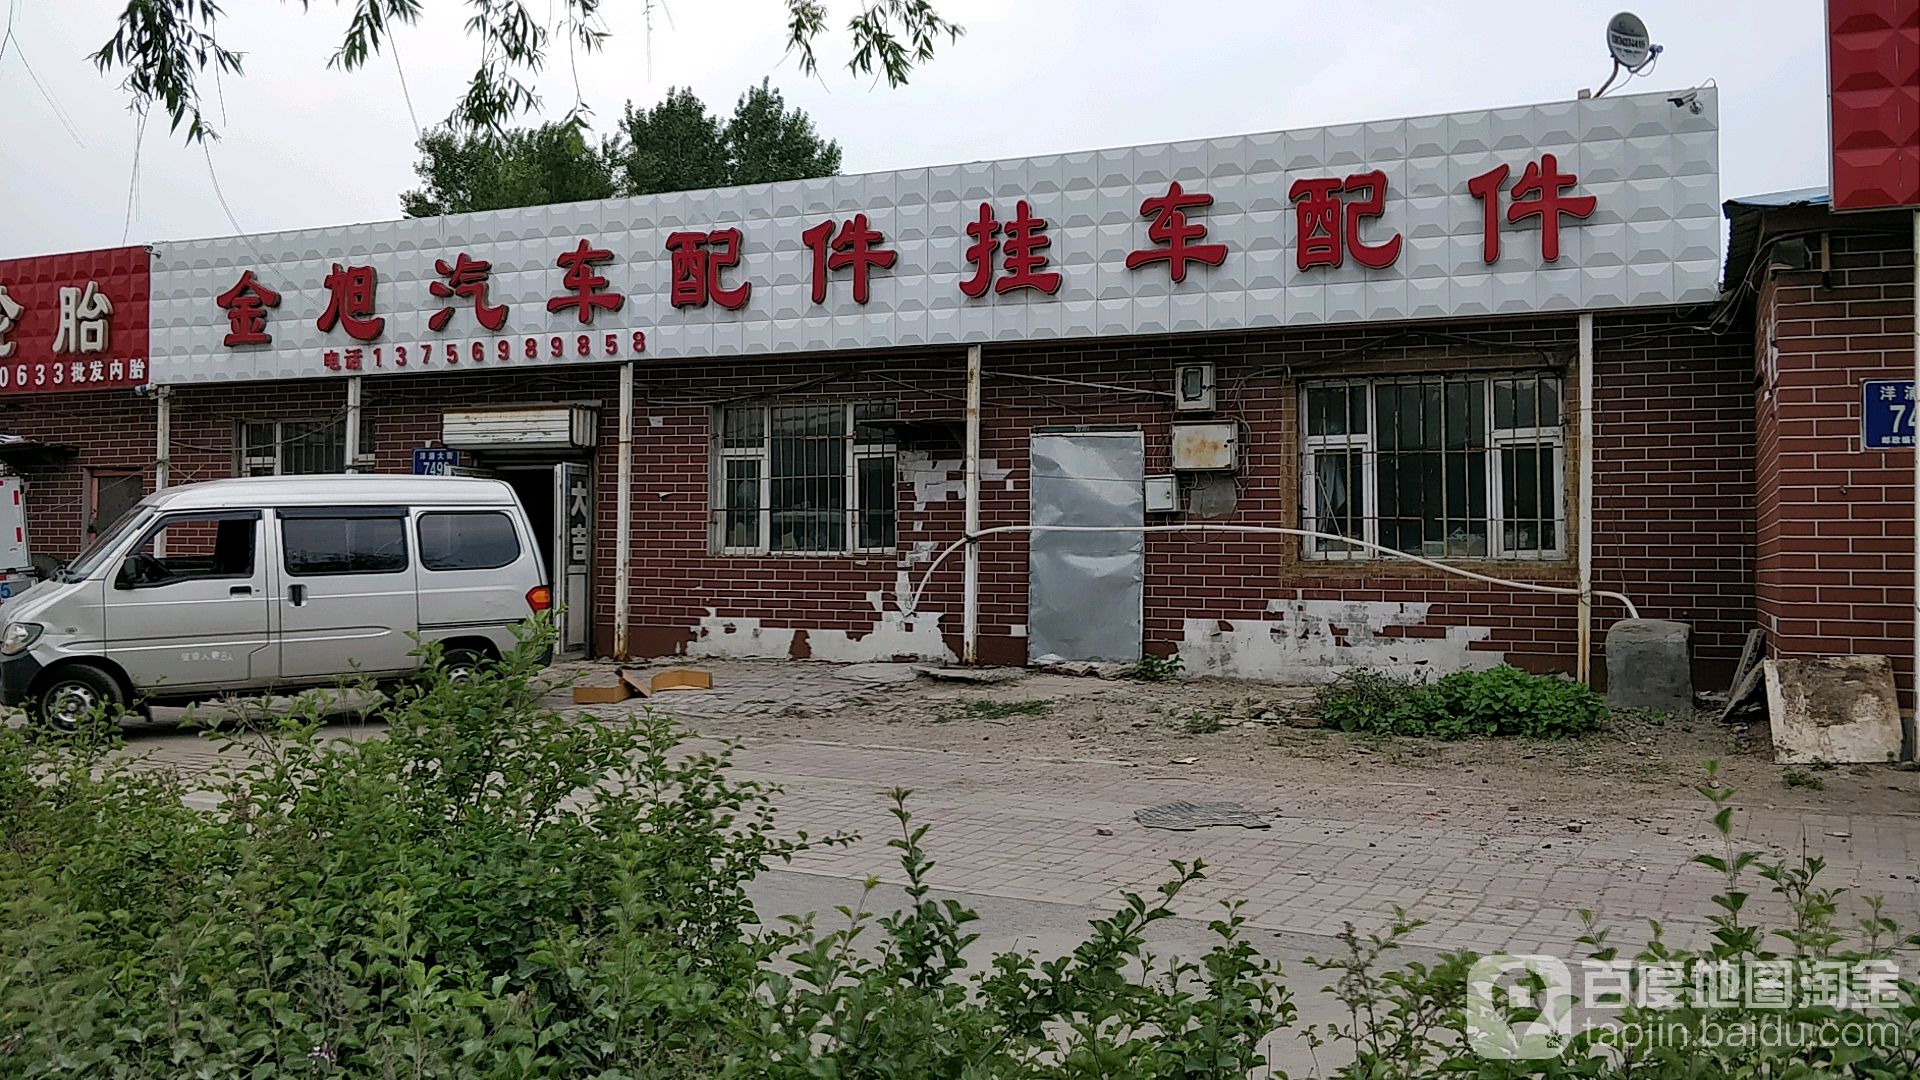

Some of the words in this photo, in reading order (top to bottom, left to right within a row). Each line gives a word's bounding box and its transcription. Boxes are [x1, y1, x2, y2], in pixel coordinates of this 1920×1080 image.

[216, 153, 1598, 347] 金旭汽车配件挂车配件
[323, 330, 647, 371] 电话13756989858
[0, 358, 145, 387] 0633批发内胎
